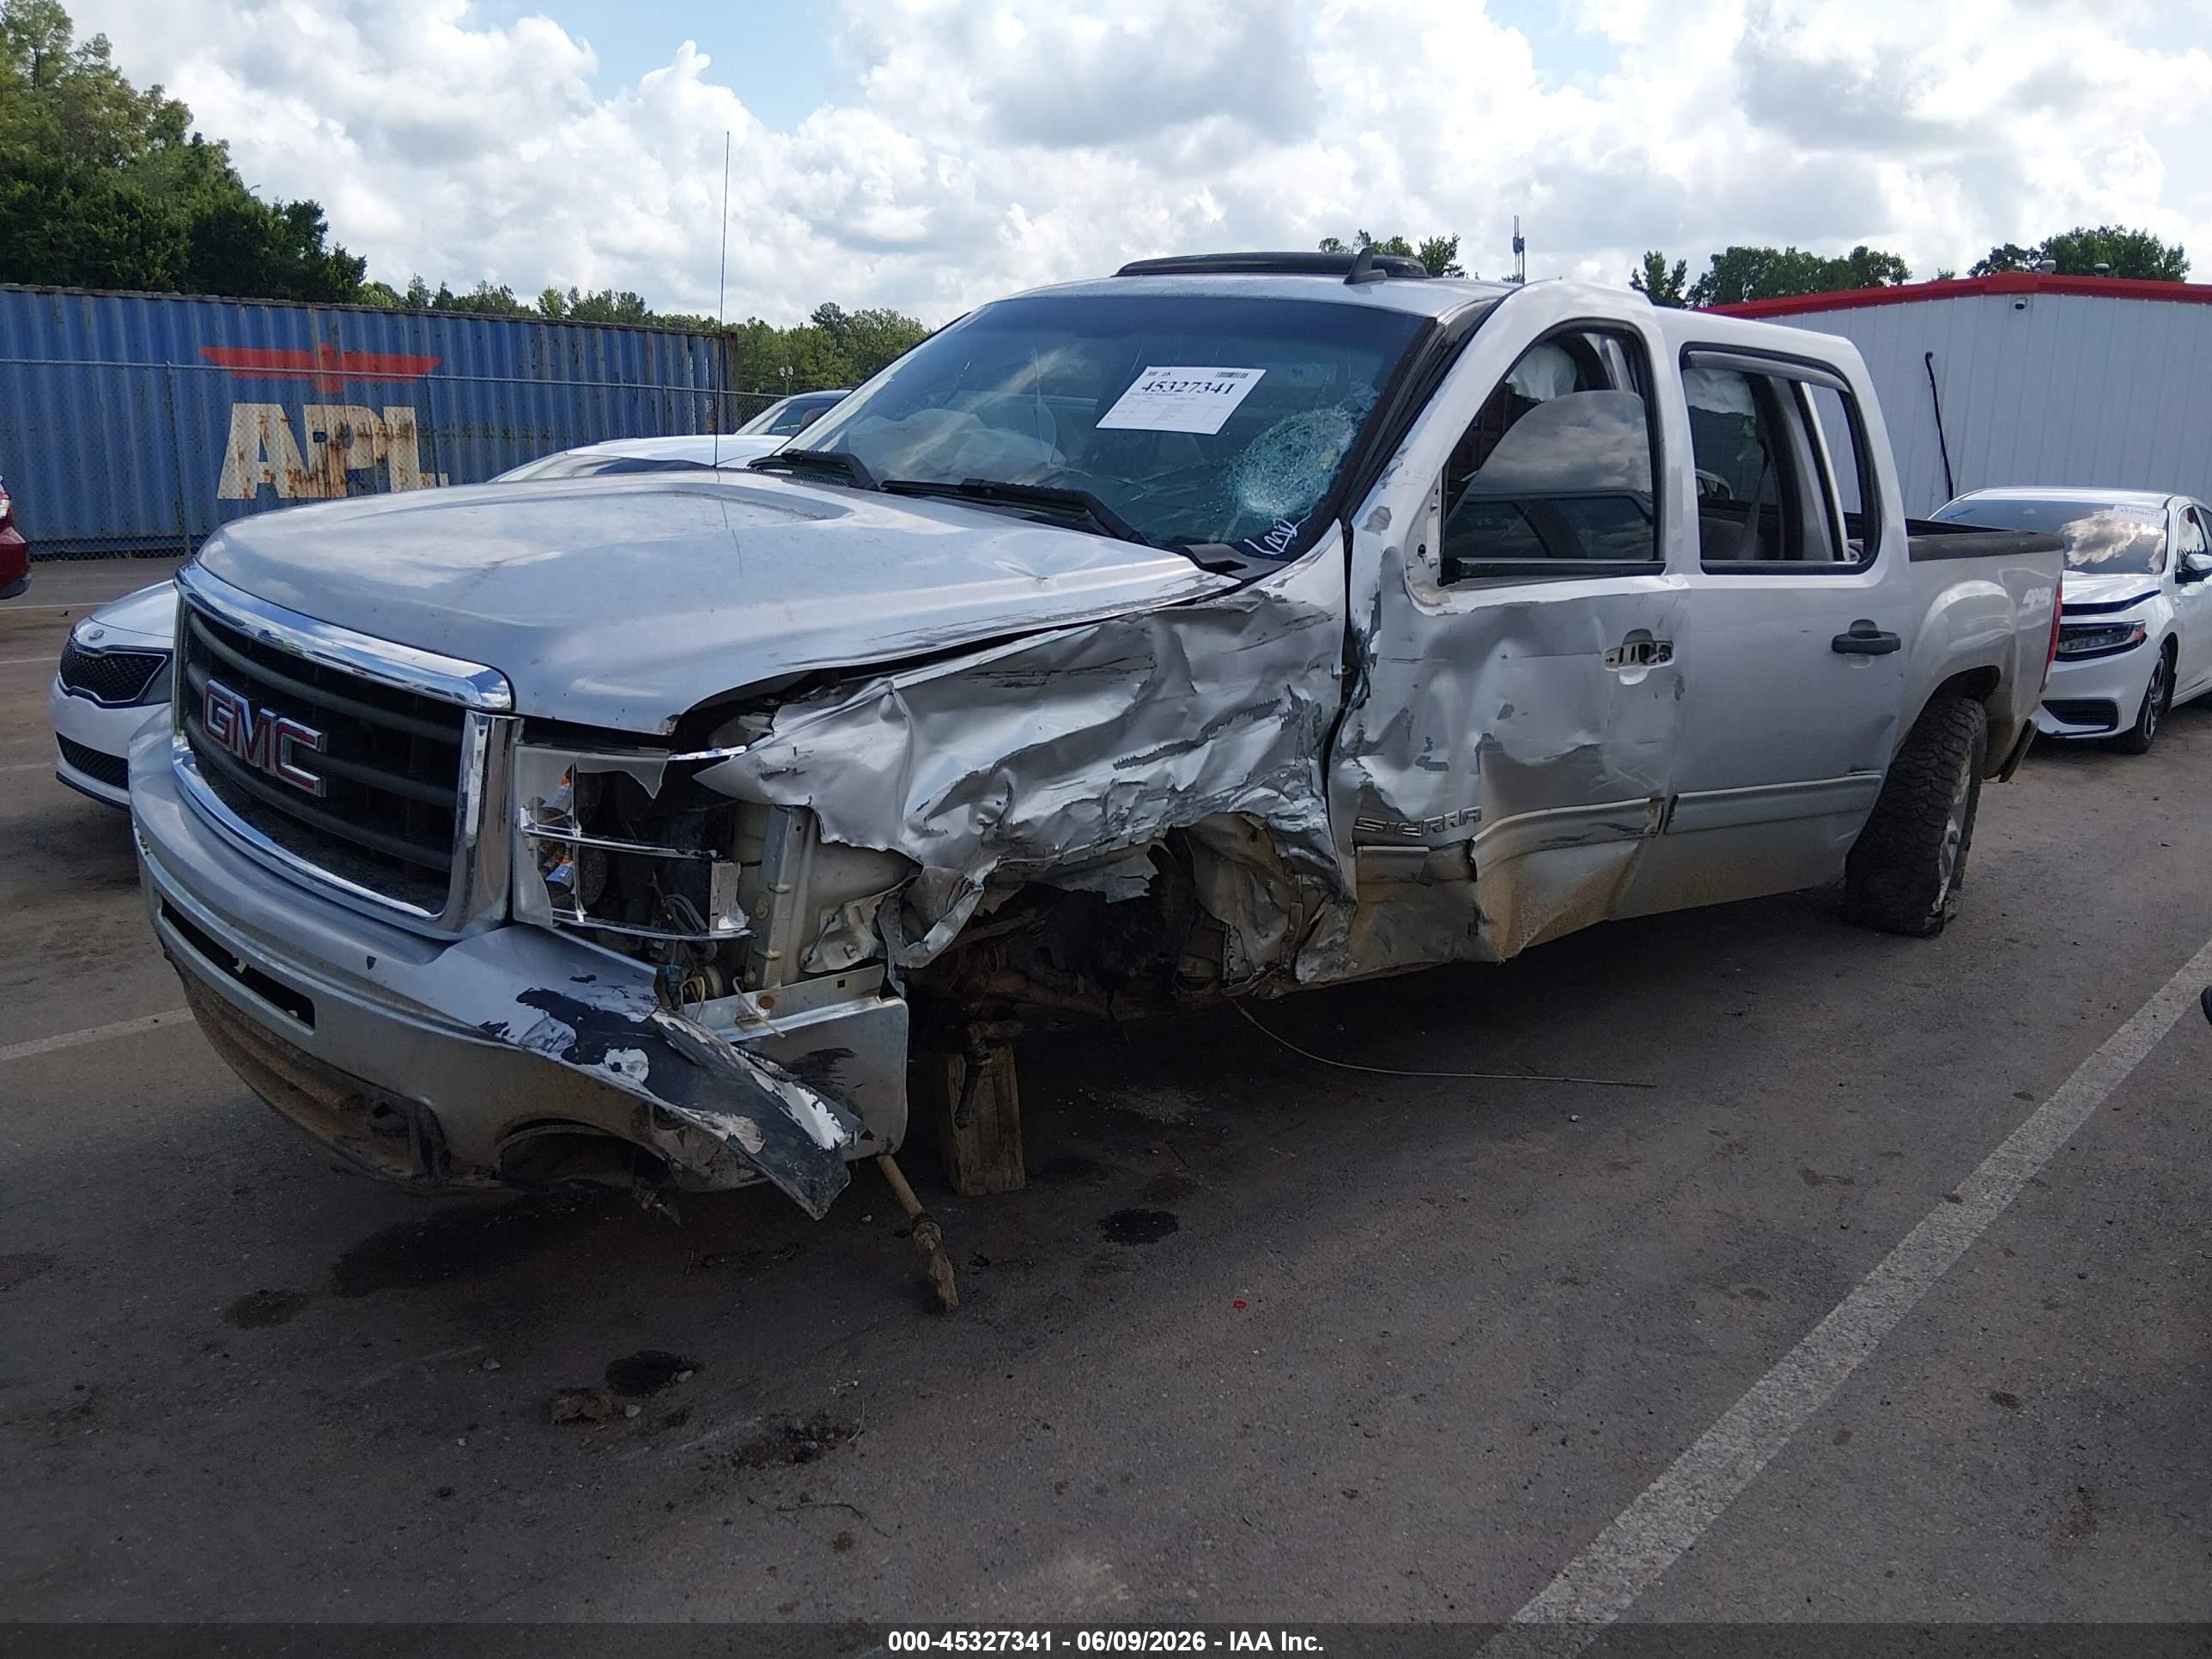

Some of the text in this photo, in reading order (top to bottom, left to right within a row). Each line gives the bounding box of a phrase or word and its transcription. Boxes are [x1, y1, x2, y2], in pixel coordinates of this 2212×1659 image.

[1141, 380, 1236, 395] 45327341
[217, 403, 449, 499] APL
[203, 679, 328, 797] GMC
[1353, 806, 1482, 837] SIERRA
